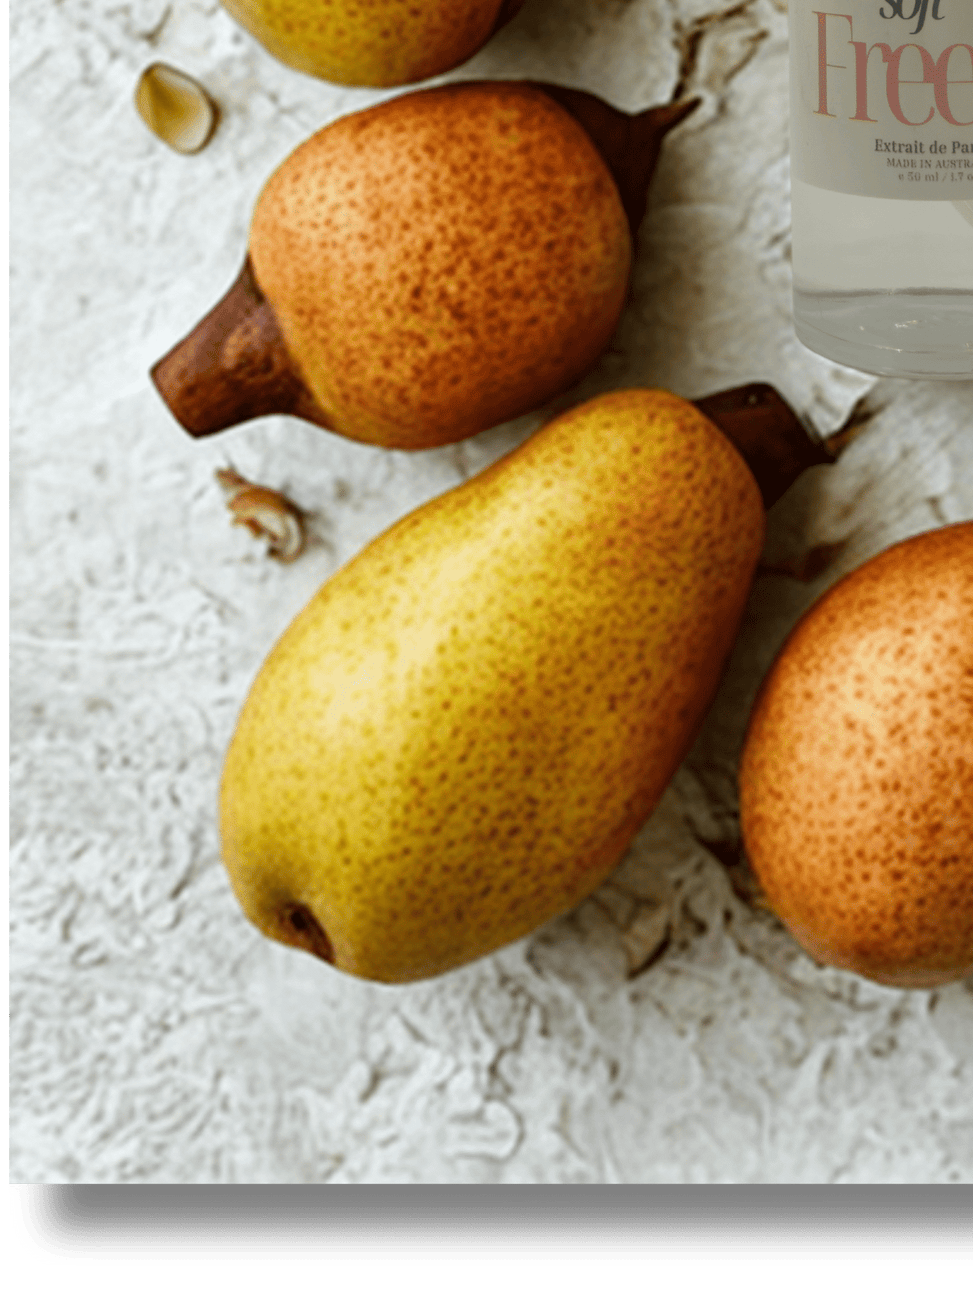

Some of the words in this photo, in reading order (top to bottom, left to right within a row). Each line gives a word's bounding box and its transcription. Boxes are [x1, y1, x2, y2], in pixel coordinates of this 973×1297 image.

[874, 138, 925, 154] Extrait
[929, 139, 947, 154] de
[886, 157, 917, 169] MADE
[920, 159, 932, 169] IN
[907, 171, 921, 182] 50
[924, 171, 939, 182] ml
[950, 171, 964, 182] 1.7
